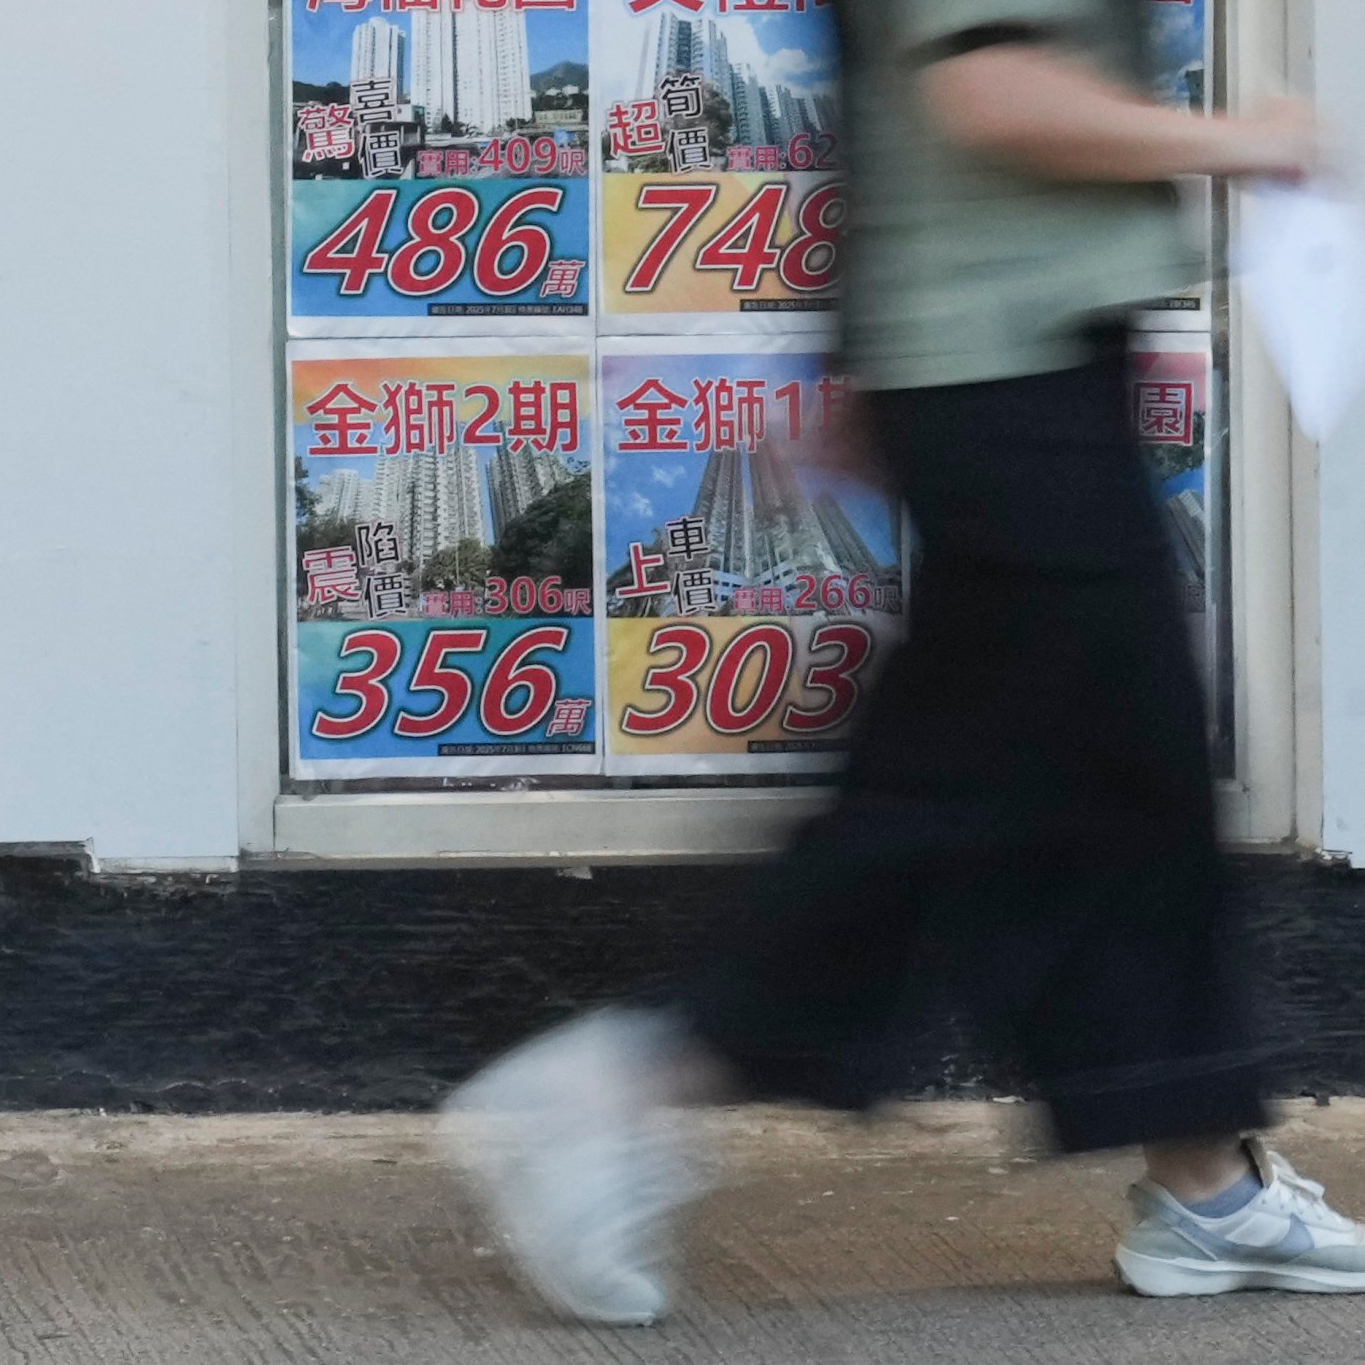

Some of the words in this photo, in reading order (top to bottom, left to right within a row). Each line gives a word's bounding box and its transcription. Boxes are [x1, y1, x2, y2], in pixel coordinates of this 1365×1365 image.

[417, 138, 585, 176] 實用:409呎
[303, 185, 585, 299] 486萬
[307, 379, 579, 457] 金獅2期
[423, 576, 591, 617] 實用:306呎
[312, 625, 591, 739] 356萬
[621, 624, 872, 736] 303
